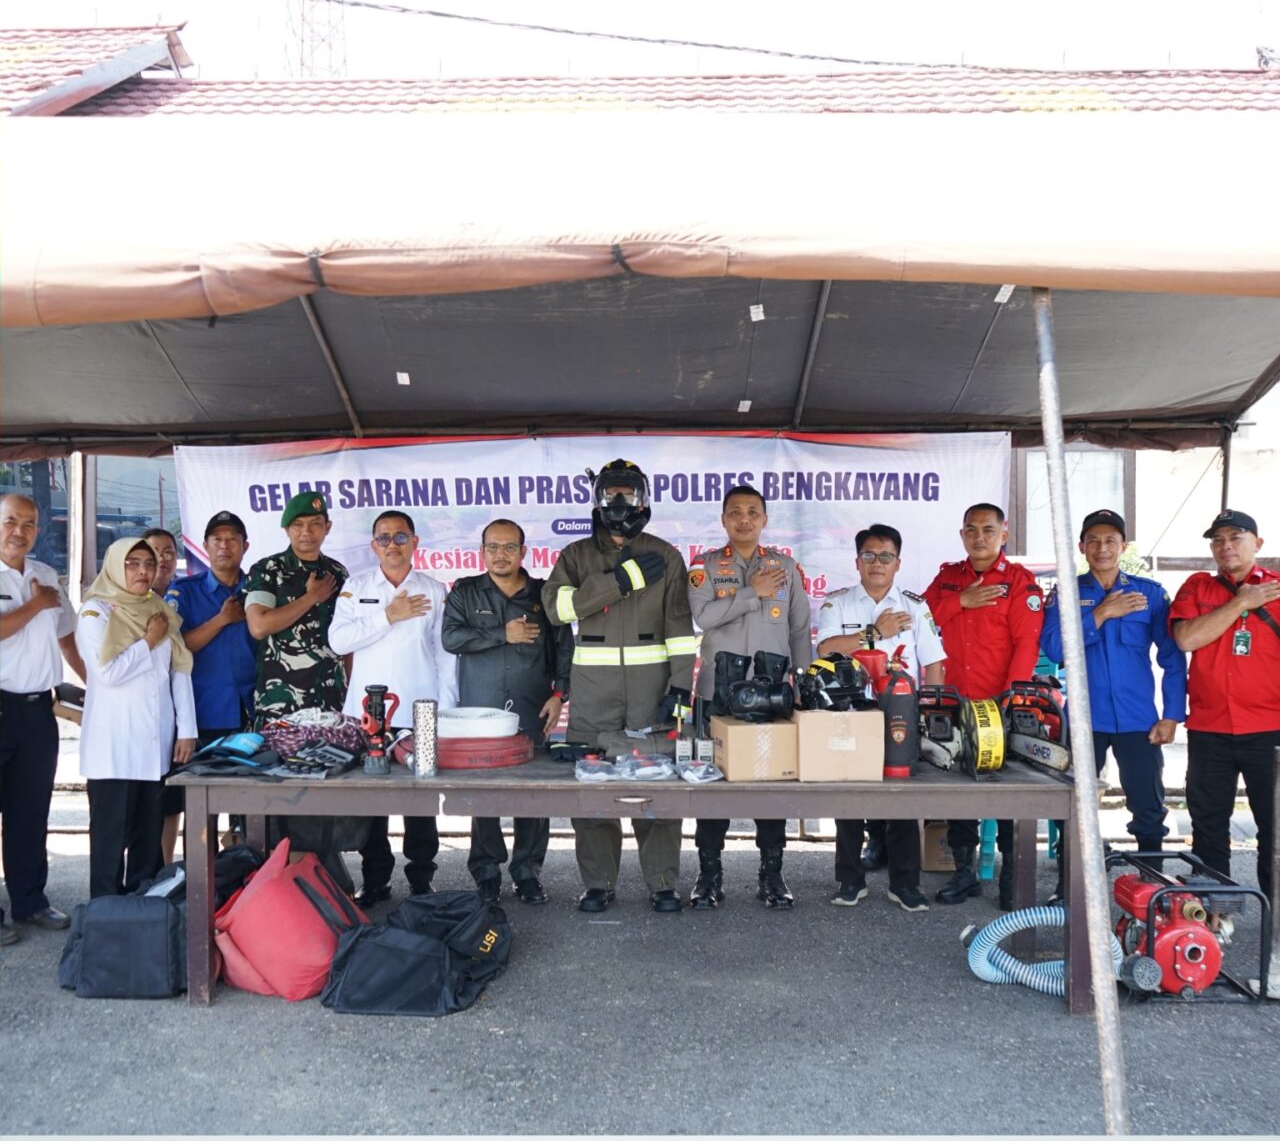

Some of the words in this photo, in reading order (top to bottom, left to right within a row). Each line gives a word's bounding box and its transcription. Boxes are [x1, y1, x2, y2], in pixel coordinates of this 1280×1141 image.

[338, 478, 450, 510] SARANA
[455, 476, 511, 506] DAN
[518, 475, 591, 504] PRAS
[762, 471, 940, 501] BENGKAYANG
[557, 521, 592, 531] Dalam
[713, 577, 740, 585] SYAHRUL
[479, 929, 498, 953] LISI
